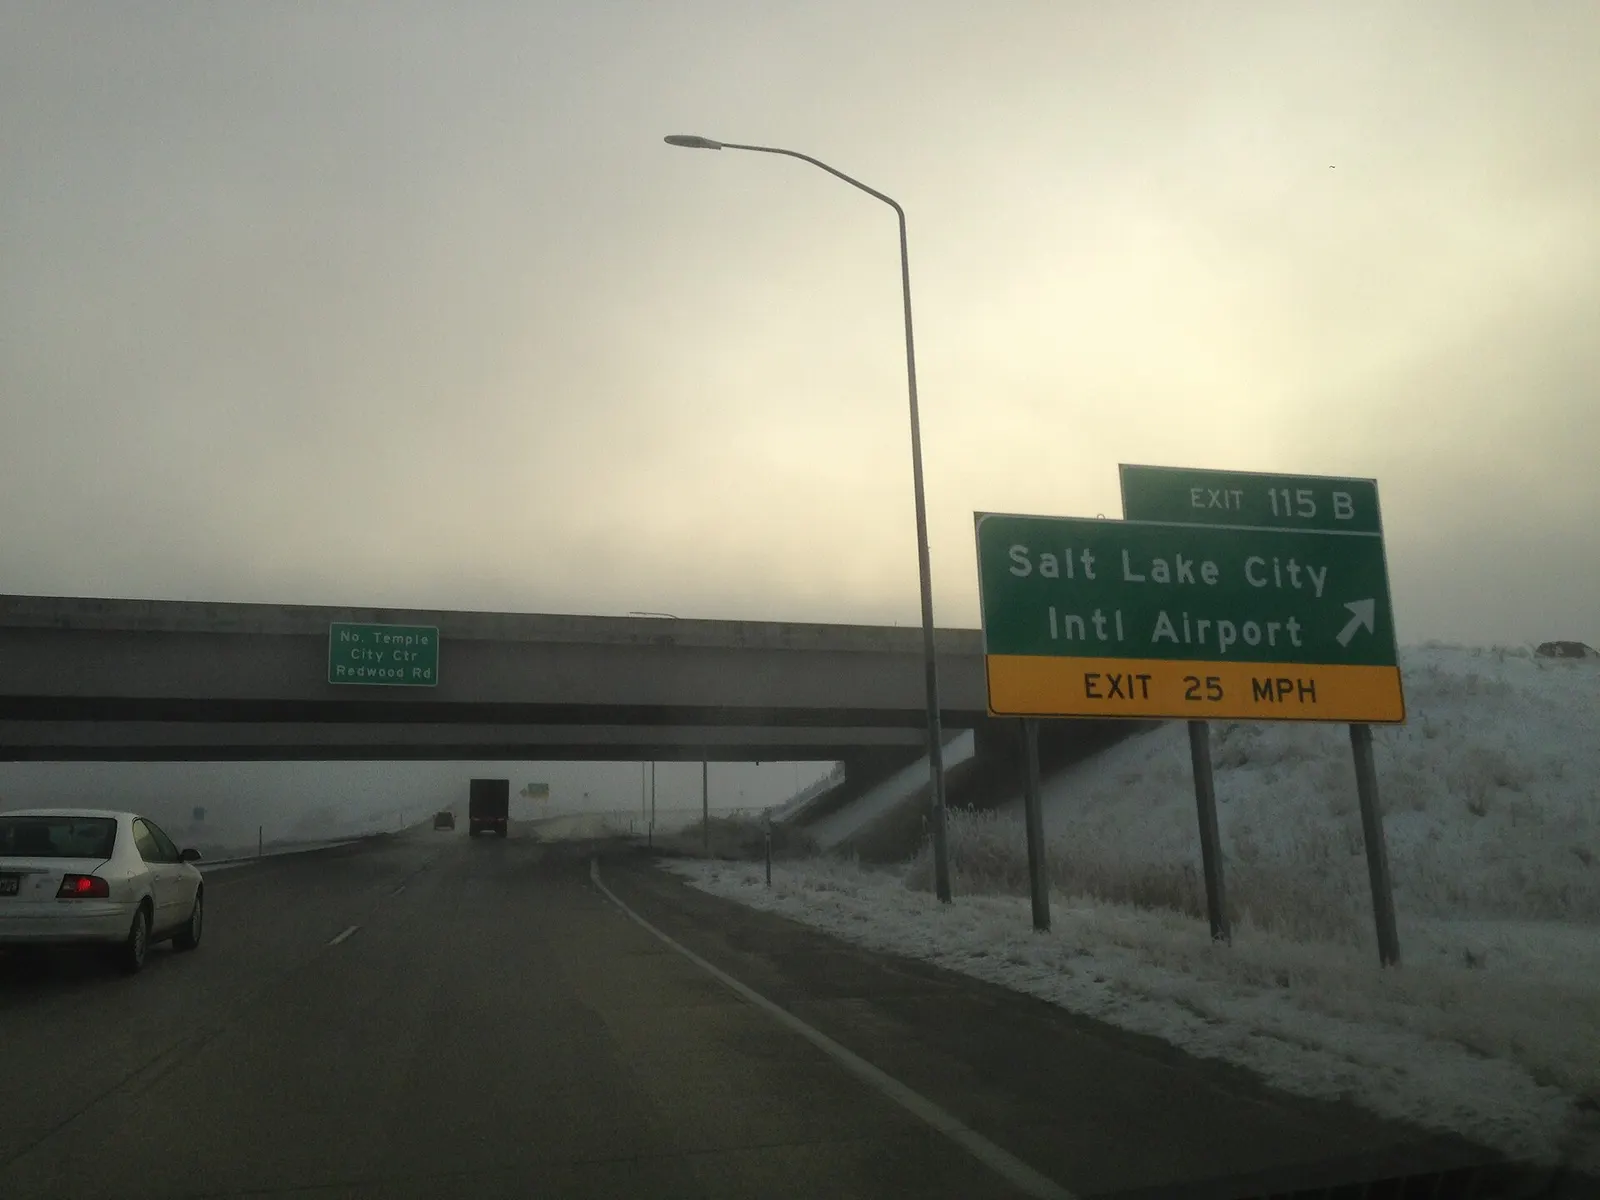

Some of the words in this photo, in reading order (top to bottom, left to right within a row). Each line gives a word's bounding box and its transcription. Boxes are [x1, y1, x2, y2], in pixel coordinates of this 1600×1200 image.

[1190, 487, 1244, 510] EXIT
[1268, 487, 1317, 519] 115
[1333, 491, 1356, 521] B
[1009, 544, 1097, 581] Salt
[1122, 549, 1220, 586] Lake
[1245, 555, 1328, 598] City
[340, 630, 364, 643] No.
[373, 632, 429, 646] Temple
[1048, 606, 1124, 642] Intl
[1151, 610, 1302, 654] Airport
[351, 648, 384, 662] City
[393, 650, 418, 661] Ctr
[336, 664, 404, 678] Redwood
[412, 667, 431, 679] Rd
[1084, 672, 1152, 700] EXIT
[1183, 675, 1224, 702] 25
[1252, 677, 1318, 704] MPH
